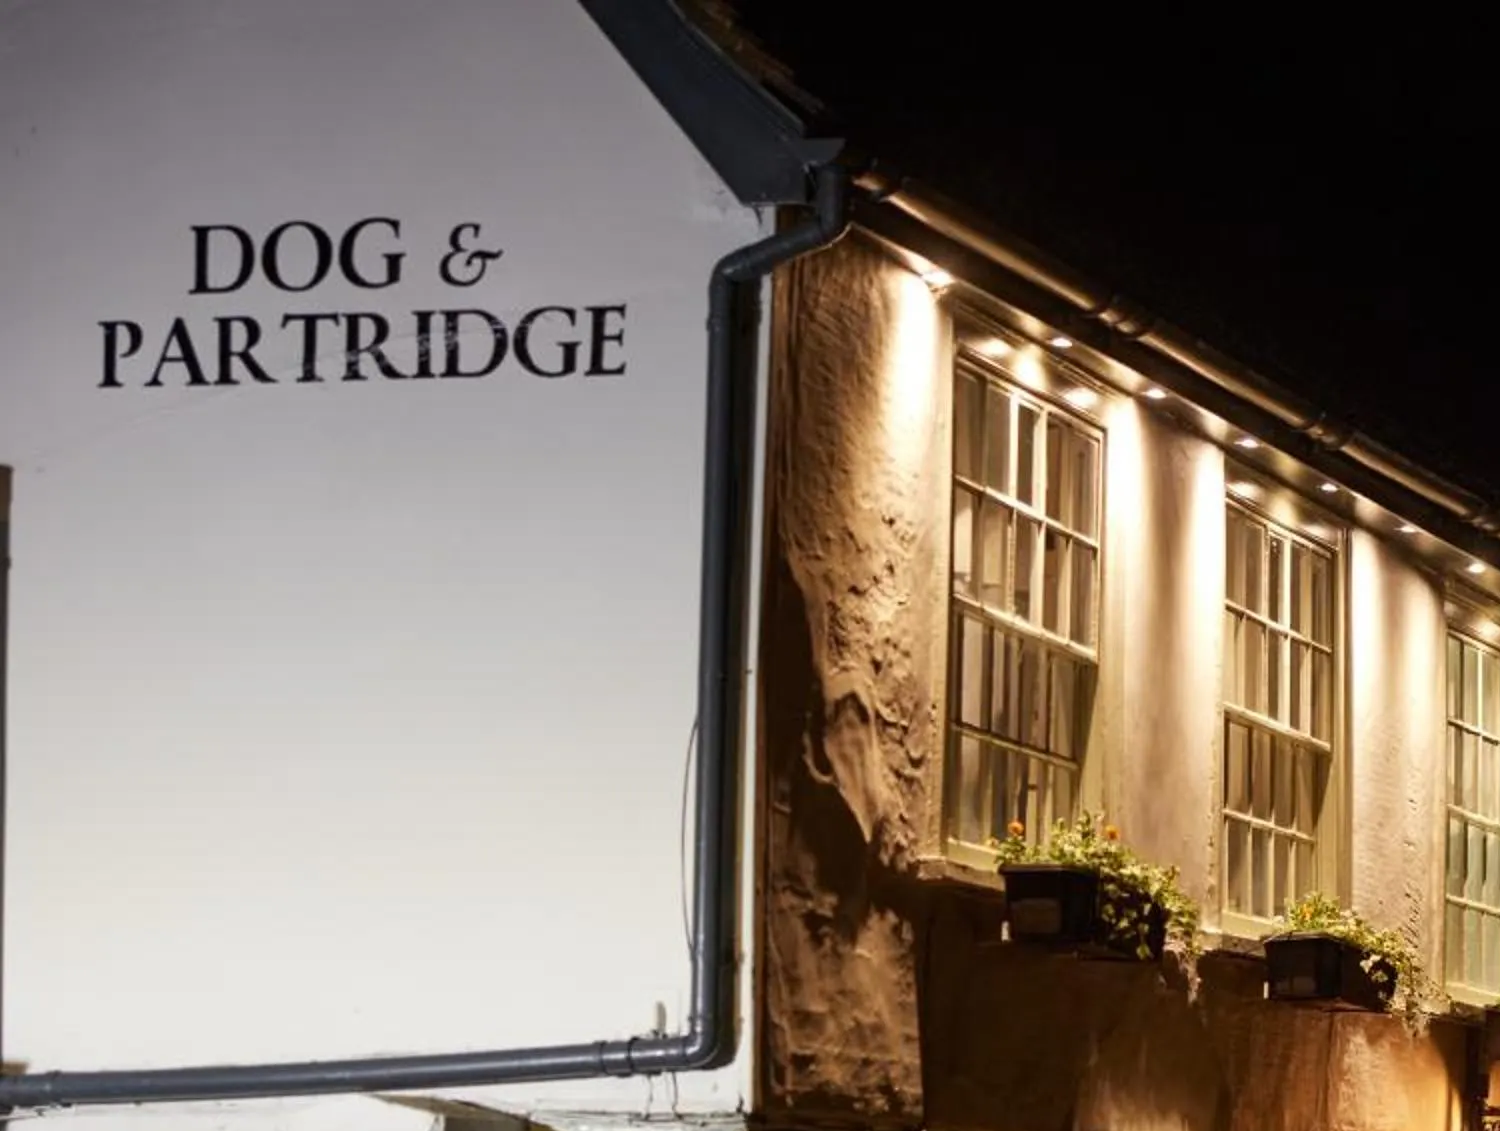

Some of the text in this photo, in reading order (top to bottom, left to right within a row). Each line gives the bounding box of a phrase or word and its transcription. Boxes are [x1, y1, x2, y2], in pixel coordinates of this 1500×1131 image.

[188, 217, 503, 295] DOG &
[98, 303, 627, 388] PARTRIDGE
